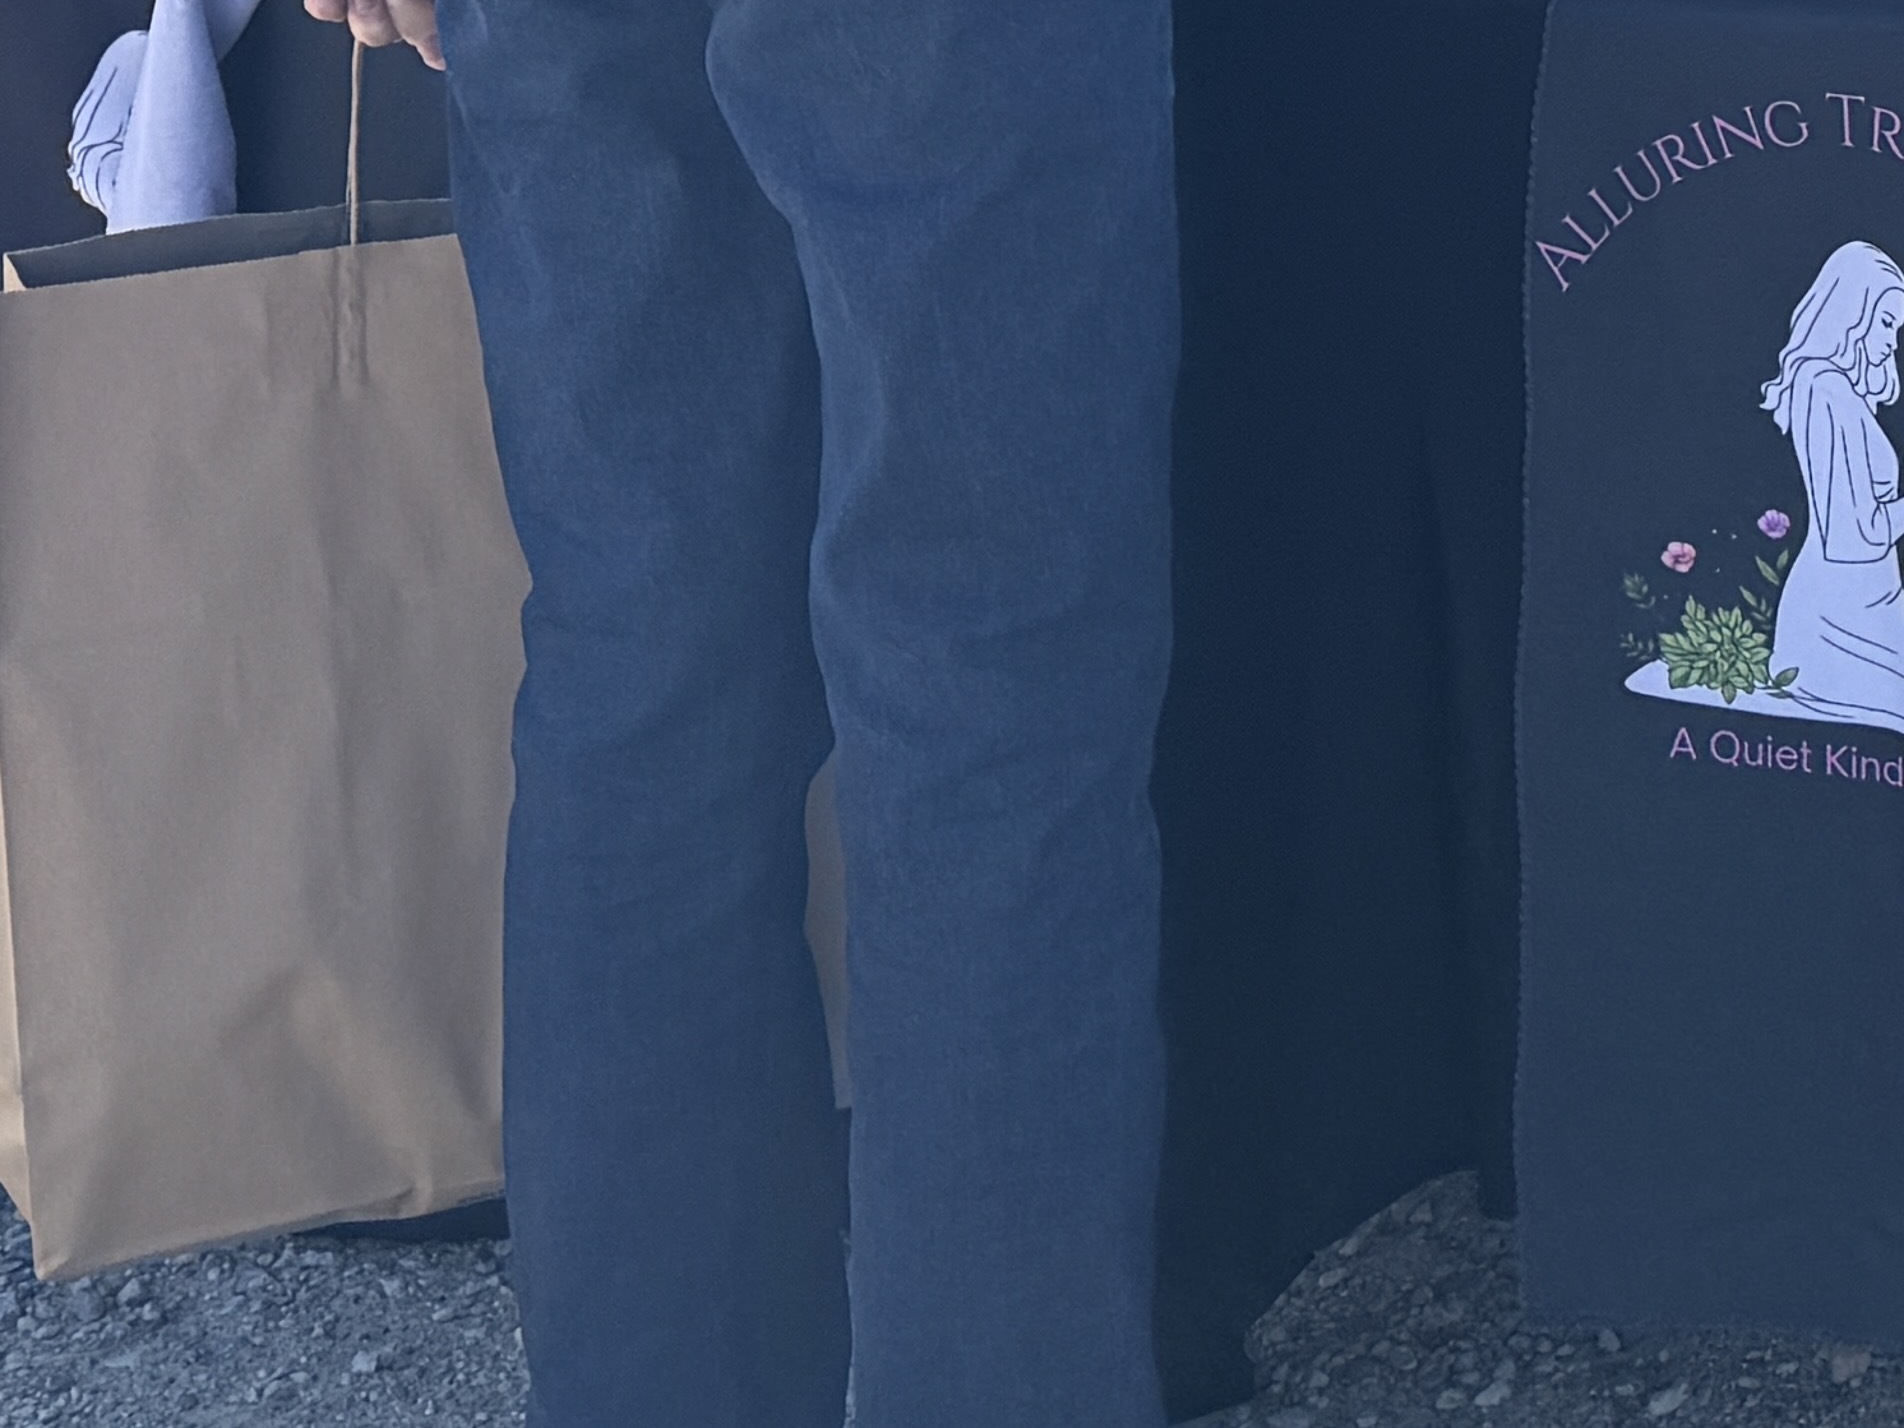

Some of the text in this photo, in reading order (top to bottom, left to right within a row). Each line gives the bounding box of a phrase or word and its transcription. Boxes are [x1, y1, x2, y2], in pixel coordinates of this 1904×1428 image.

[1535, 101, 1809, 292] ALLURING
[1669, 727, 1697, 760] A
[1709, 730, 1812, 774] Quiet
[1825, 744, 1904, 787] Kind
